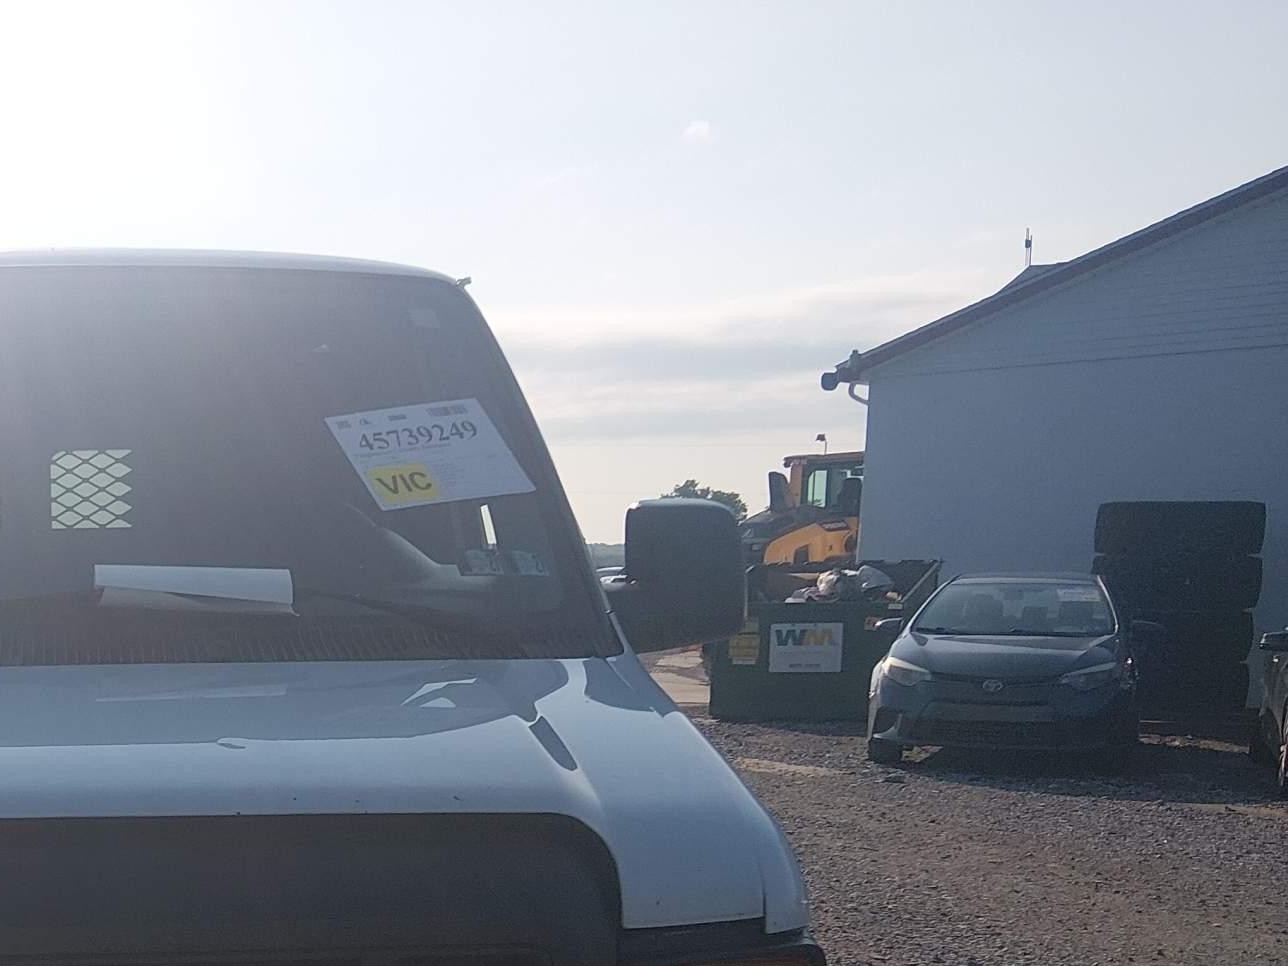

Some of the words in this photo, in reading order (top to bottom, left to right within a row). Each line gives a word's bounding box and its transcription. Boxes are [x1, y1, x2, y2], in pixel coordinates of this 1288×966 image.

[359, 420, 477, 450] 45739249
[376, 471, 432, 494] VIC
[775, 628, 835, 646] WM
